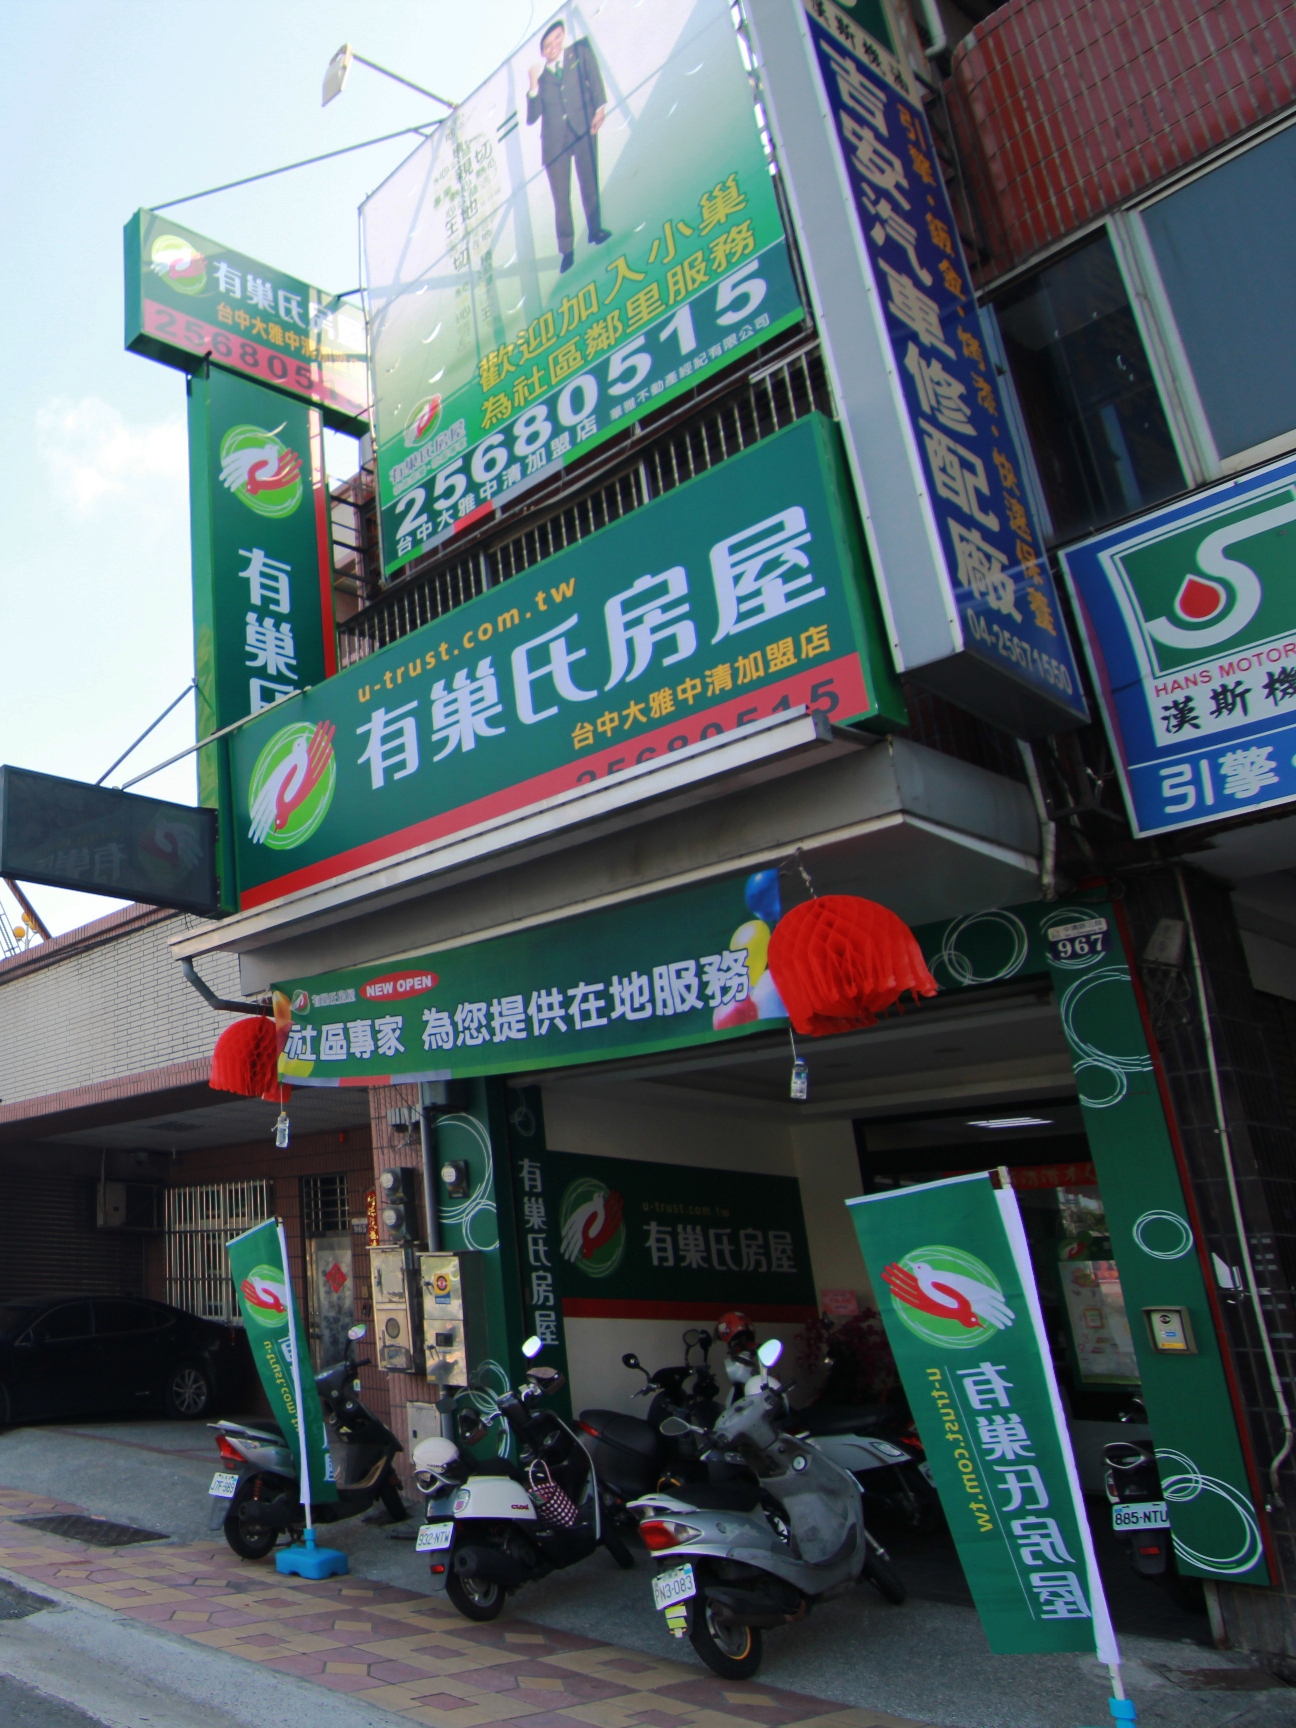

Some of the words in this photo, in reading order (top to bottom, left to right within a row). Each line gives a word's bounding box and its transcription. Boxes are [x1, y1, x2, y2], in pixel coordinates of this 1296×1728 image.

[477, 171, 747, 393] 歡迎加入小巢
[480, 220, 756, 430] 為社區鄰里服務
[820, 38, 1022, 625] 吉安汽車修配廠
[390, 418, 466, 483] 有巢氏房屋
[395, 258, 767, 540] 25680515
[396, 415, 597, 557] 台中大雅中清加盟店
[356, 505, 827, 791] 有巢氏房屋
[357, 576, 578, 703] u-trust.com.tw
[570, 624, 832, 750] 台中大雅中清加盟店
[1154, 670, 1213, 698] HANS
[283, 1014, 406, 1061] 社區專家
[421, 949, 750, 1053] 為您提供在地服務
[366, 982, 394, 998] NEW
[396, 975, 432, 992] OPEN
[1057, 934, 1103, 958] 967
[518, 1158, 560, 1345] 有巢氏房屋
[642, 1201, 730, 1218] u-trust.com.tw
[642, 1221, 798, 1273] 有巢氏房屋
[1114, 1510, 1169, 1526] 885-NTU
[654, 1575, 693, 1605] PN3-083
